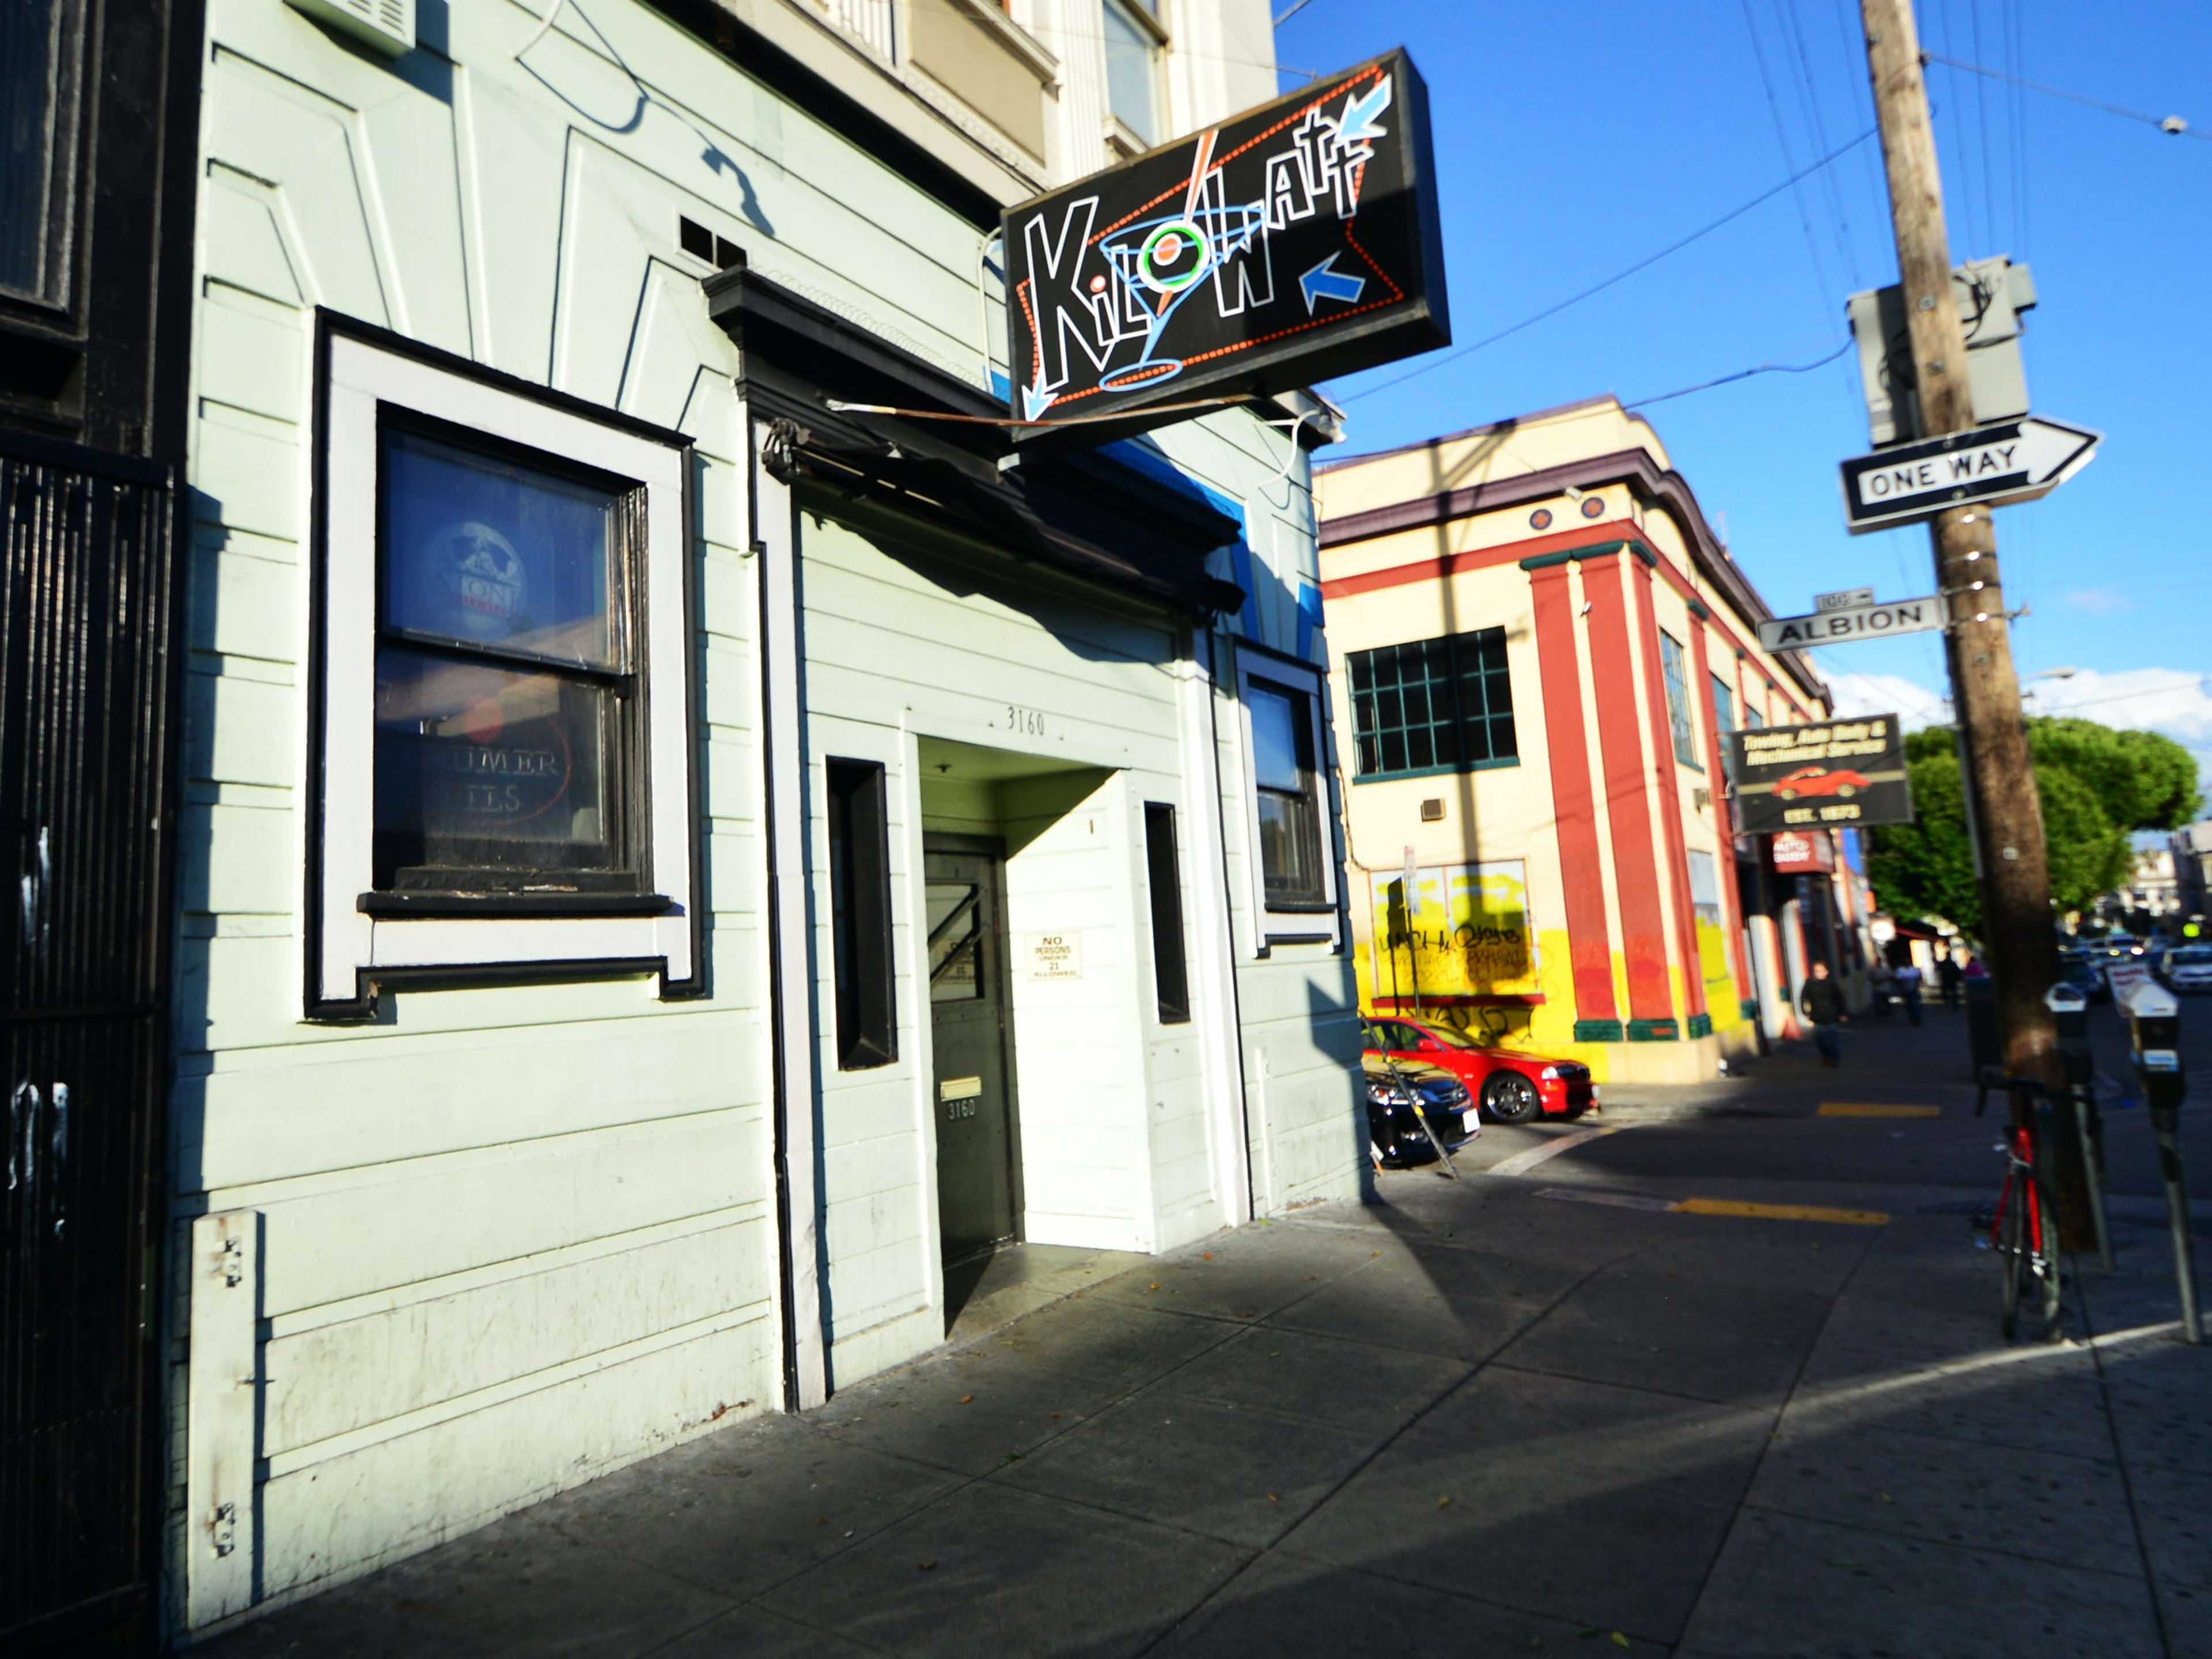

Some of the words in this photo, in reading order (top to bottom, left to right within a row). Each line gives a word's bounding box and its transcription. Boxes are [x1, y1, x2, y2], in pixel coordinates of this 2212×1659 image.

[1871, 463, 1936, 498] ONE
[1948, 445, 2017, 480] WAY
[1777, 604, 1922, 644] ALBION
[1007, 706, 1044, 736] 3160
[1043, 937, 1062, 945] NO
[1049, 961, 1059, 970] 21
[948, 1099, 976, 1120] 3160
